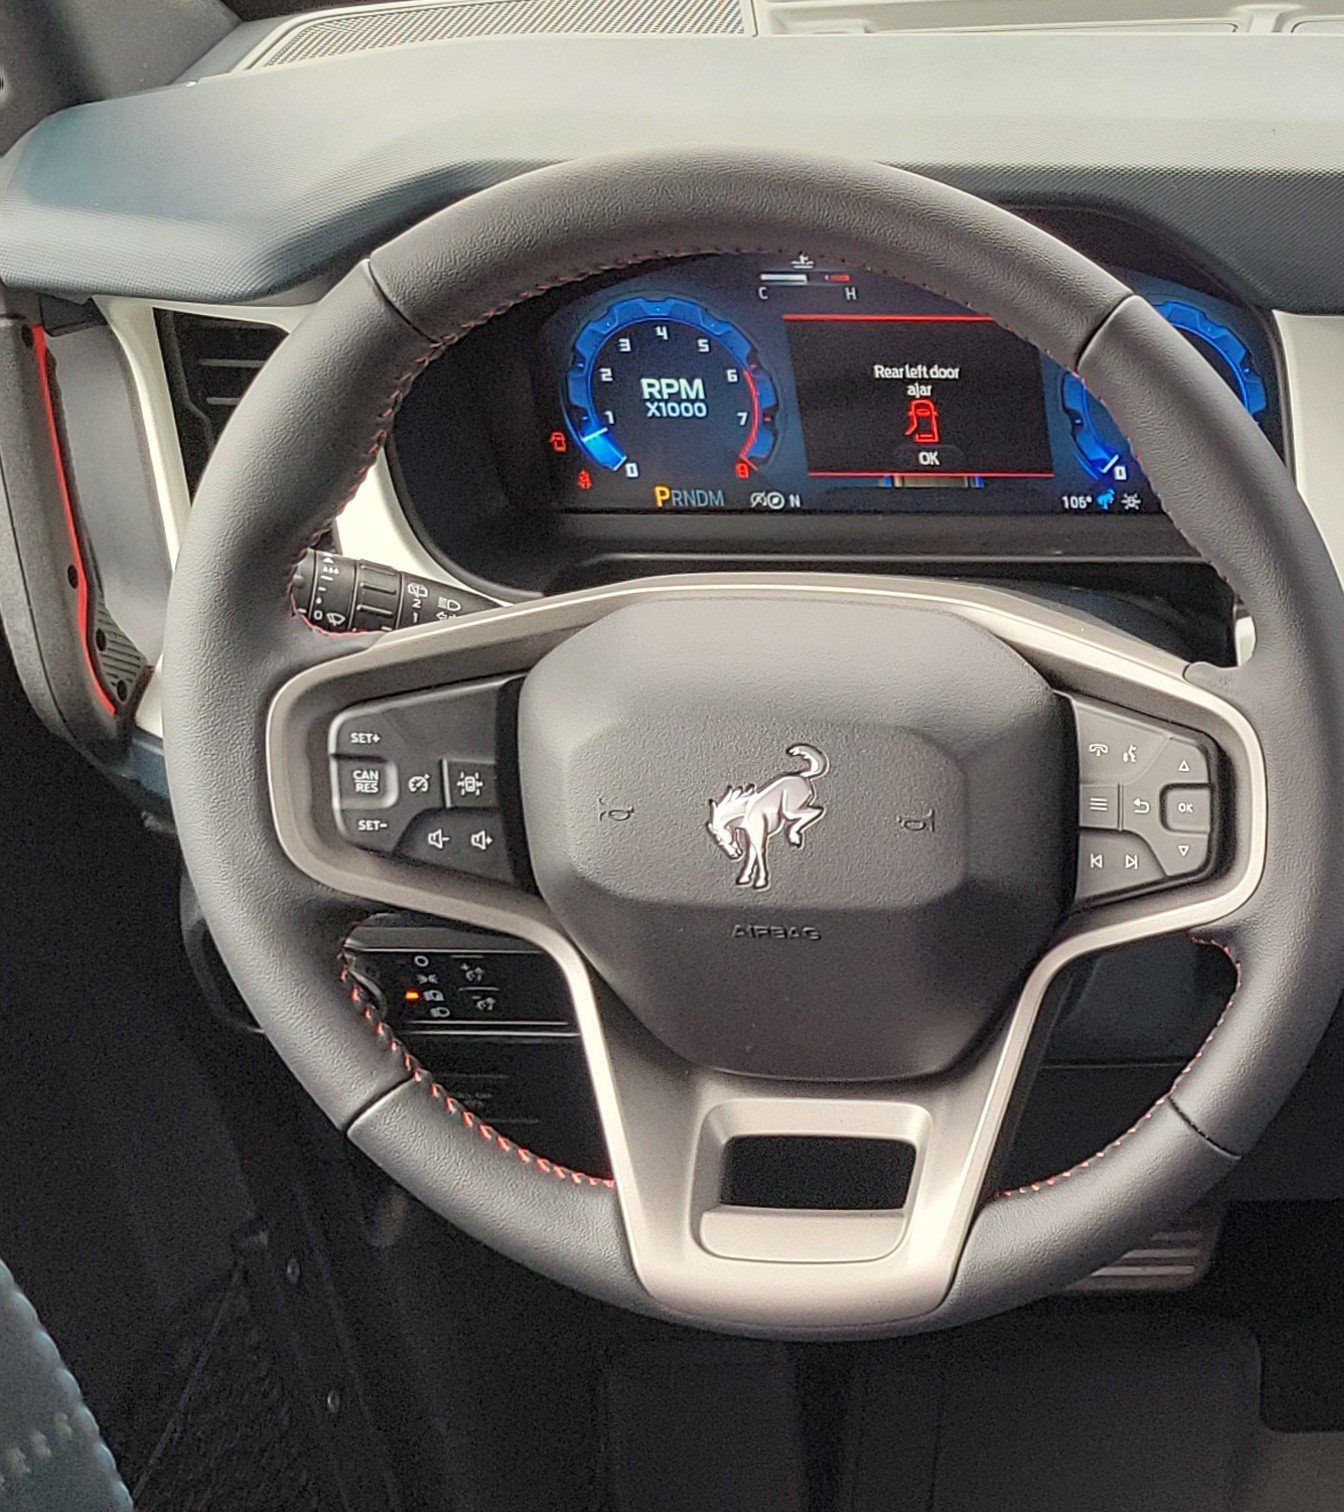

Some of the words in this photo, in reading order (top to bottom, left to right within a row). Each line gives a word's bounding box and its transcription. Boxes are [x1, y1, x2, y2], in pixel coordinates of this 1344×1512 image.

[758, 287, 768, 300] C
[845, 287, 856, 300] H
[656, 326, 668, 340] 4
[619, 338, 631, 352] 3
[698, 338, 710, 352] 5
[600, 368, 613, 382] 2
[727, 368, 738, 383] 6
[874, 365, 904, 379] Rear
[905, 365, 929, 379] left
[930, 365, 960, 379] door
[640, 378, 705, 399] RPM
[646, 402, 706, 417] X1000
[604, 411, 615, 424] 1
[737, 412, 749, 425] 7
[918, 451, 940, 466] OK
[626, 463, 638, 477] 0
[1114, 466, 1127, 480] 0
[789, 494, 801, 508] N
[413, 598, 422, 609] 2
[353, 770, 379, 780] CAN
[355, 782, 379, 793] RES
[1178, 803, 1193, 813] OK
[731, 923, 822, 941] AIRBAG
